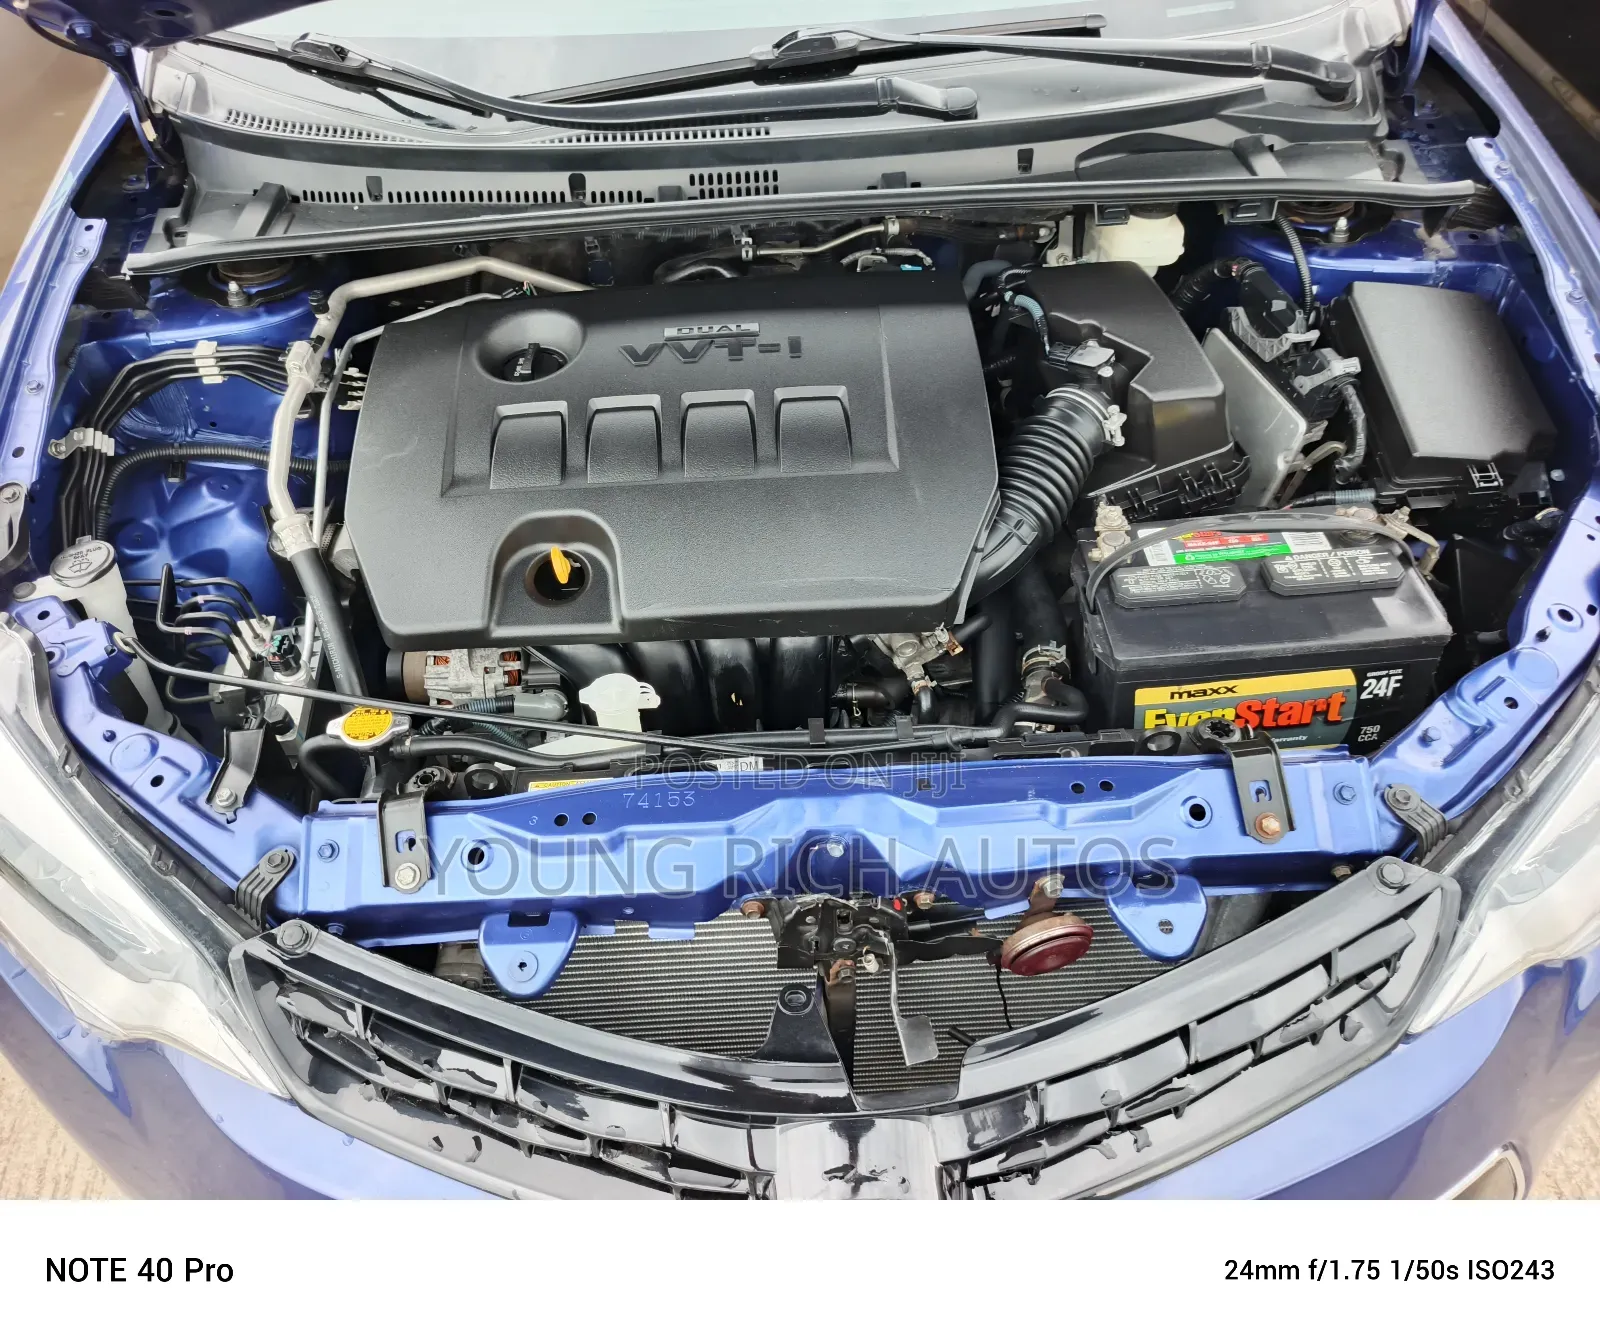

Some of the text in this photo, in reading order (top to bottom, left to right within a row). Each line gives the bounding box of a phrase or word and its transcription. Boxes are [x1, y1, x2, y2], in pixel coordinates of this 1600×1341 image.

[677, 324, 751, 335] DUAL
[1293, 552, 1329, 561] DANGER
[1337, 549, 1371, 557] POISON
[1169, 685, 1239, 700] maxx
[1360, 675, 1403, 699] 24F
[1360, 725, 1380, 734] 750
[1358, 734, 1378, 742] CCA
[623, 791, 696, 809] 74153
